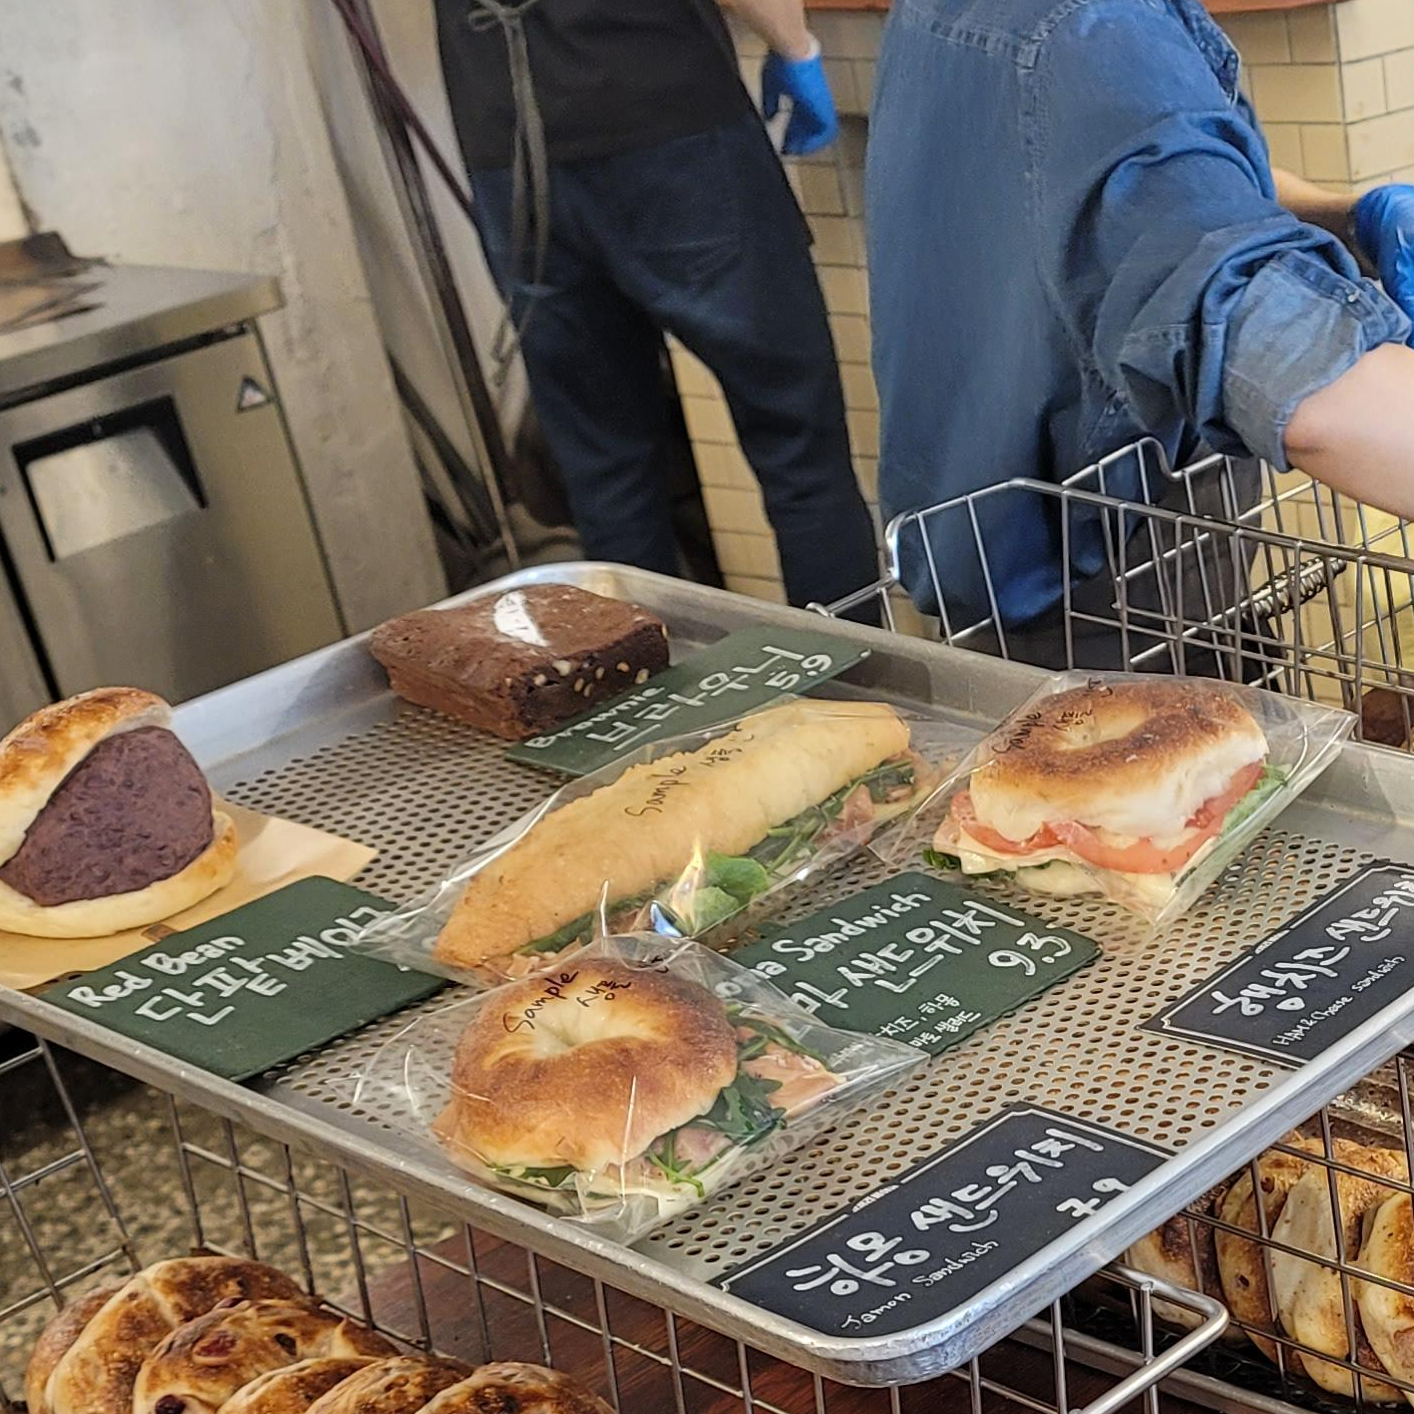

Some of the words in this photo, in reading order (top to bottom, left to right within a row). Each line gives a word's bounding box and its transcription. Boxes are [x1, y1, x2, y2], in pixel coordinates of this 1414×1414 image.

[586, 646, 804, 750] 브라우니
[764, 654, 833, 690] 5.9
[524, 687, 665, 748] Brownie
[625, 765, 687, 817] Sample
[771, 893, 931, 963] Sandwich
[837, 900, 1026, 993] 샌드위치
[987, 931, 1073, 976] 9.3
[67, 970, 153, 1008] Red
[141, 936, 246, 976] Bean
[503, 970, 580, 1034] Sample
[785, 1231, 932, 1297] 하몽
[840, 1290, 913, 1332] Jamon
[912, 1238, 1000, 1289] Sandwich
